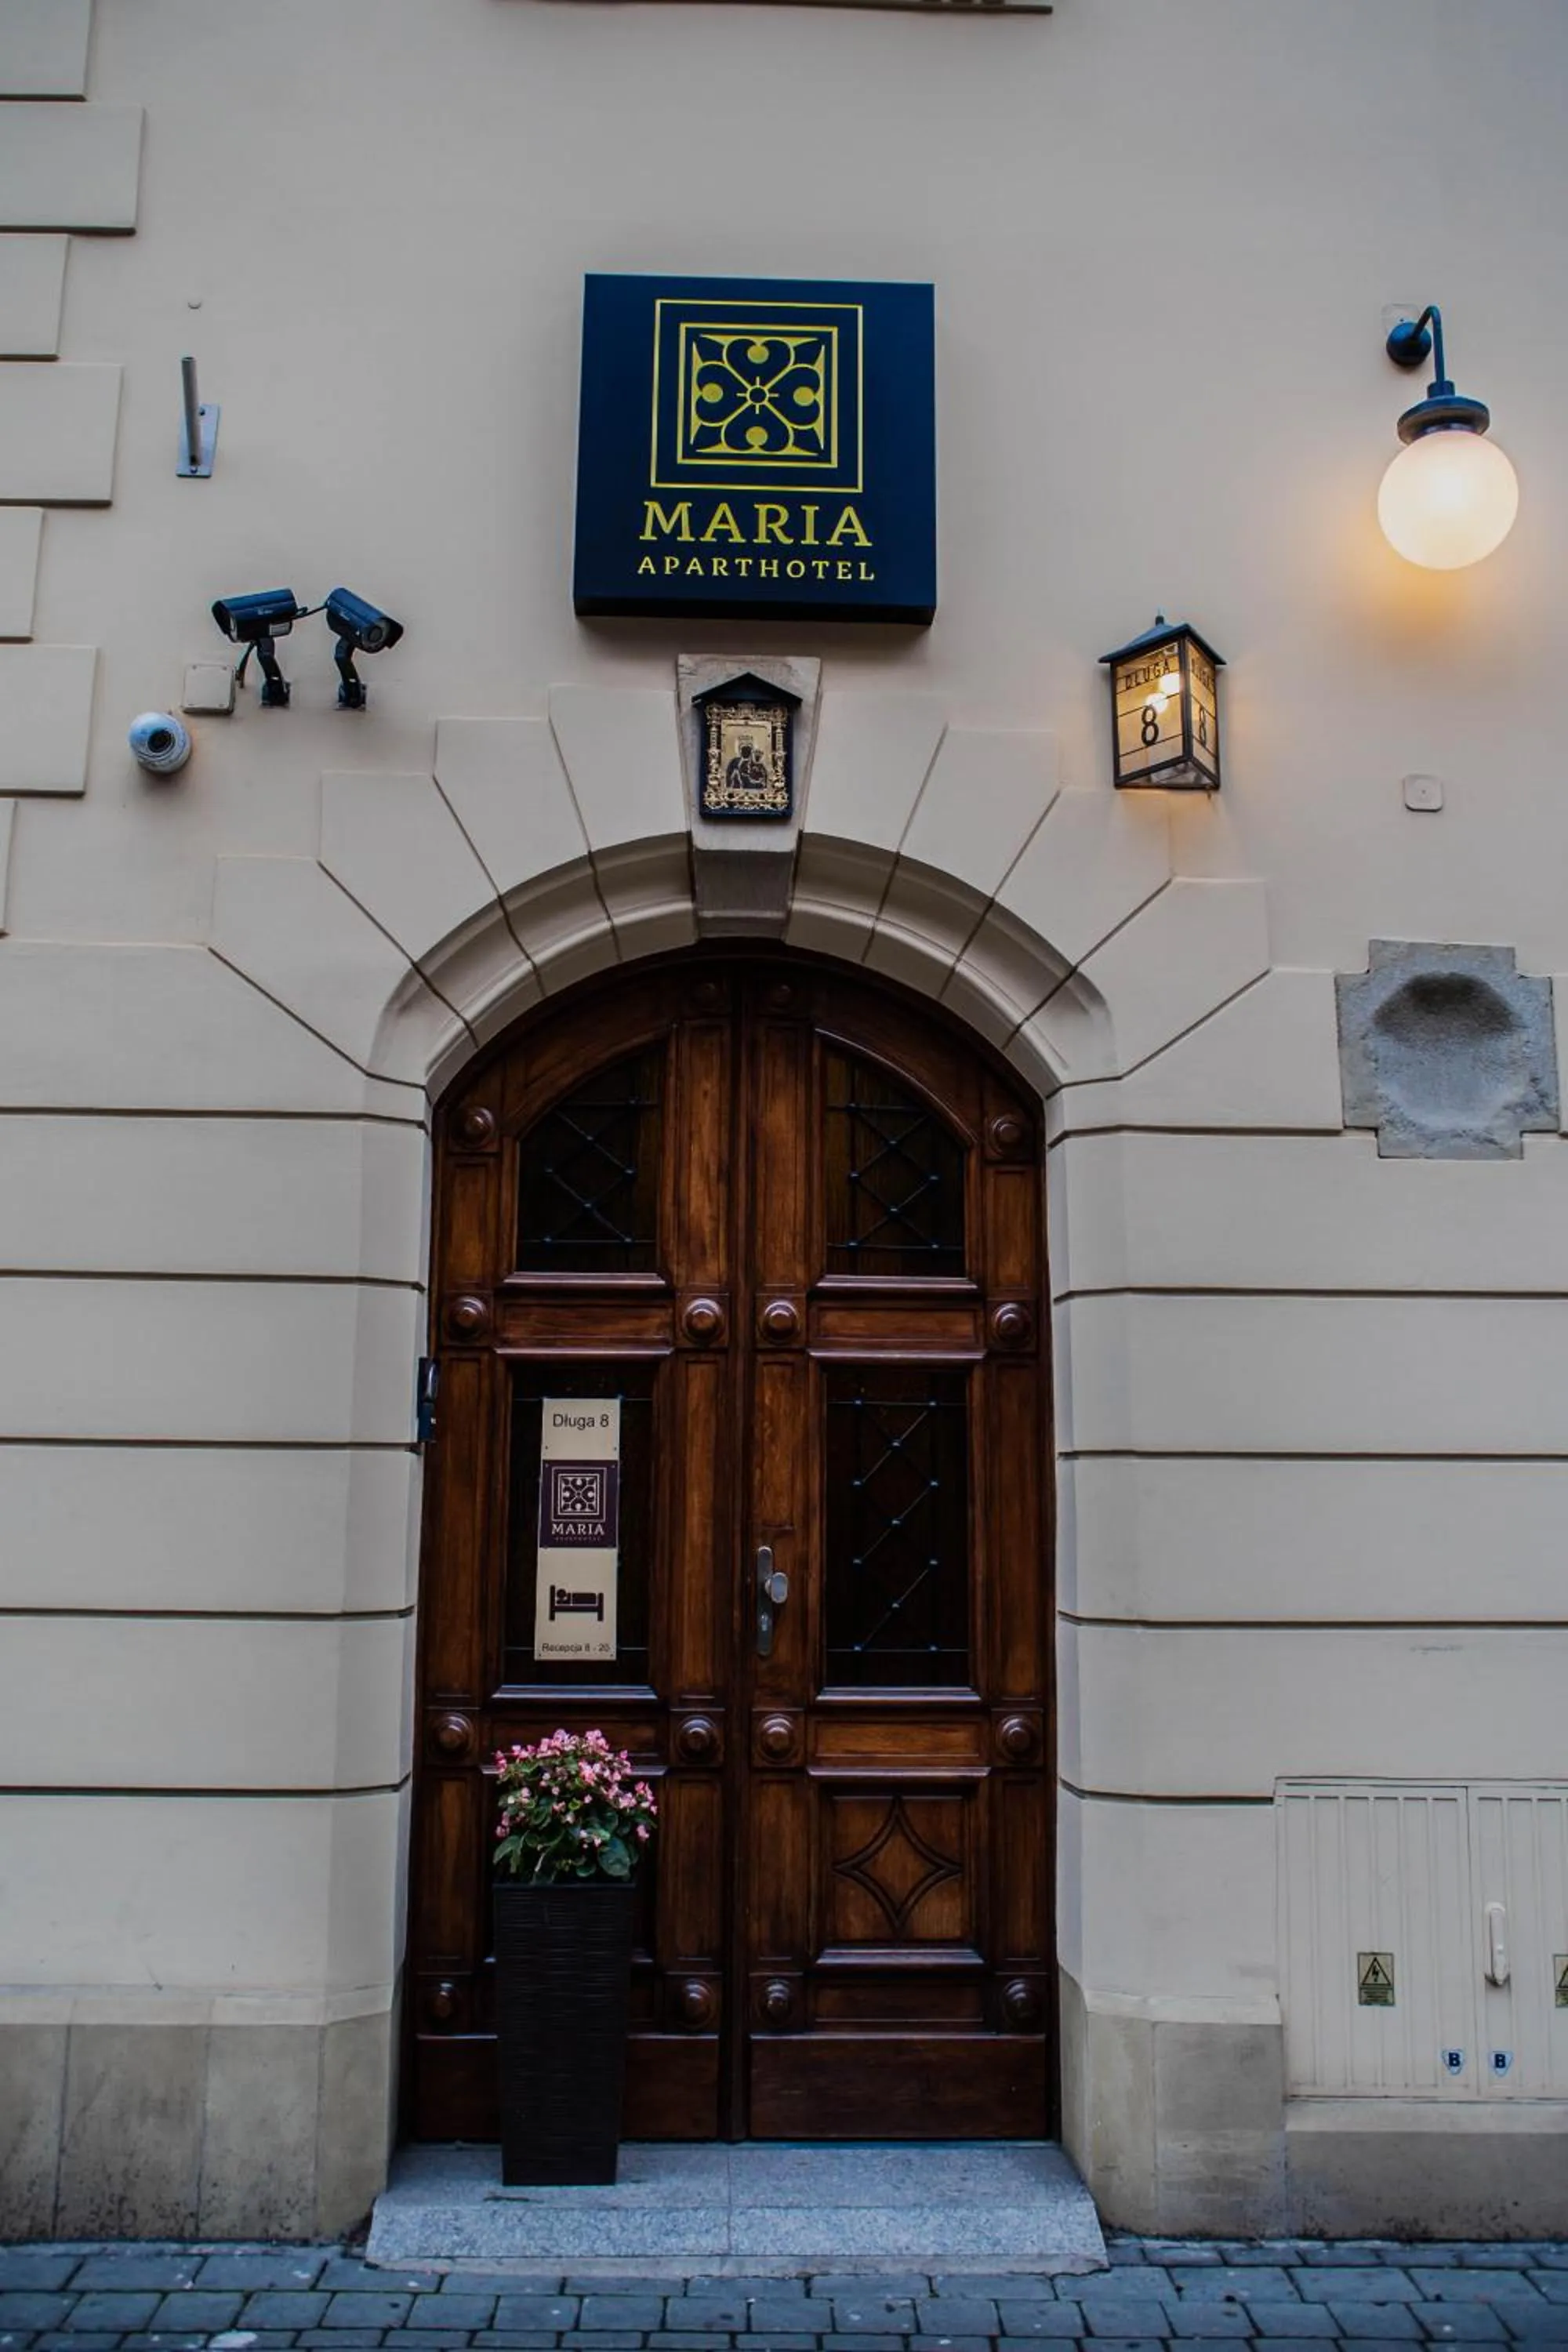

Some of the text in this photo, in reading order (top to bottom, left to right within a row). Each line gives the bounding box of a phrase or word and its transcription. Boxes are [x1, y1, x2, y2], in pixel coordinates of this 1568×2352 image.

[639, 502, 873, 546] MARIA
[637, 556, 875, 581] APARTHOTEL
[1142, 705, 1159, 746] 8
[553, 1413, 609, 1431] Długa 8
[551, 1523, 605, 1535] MARIA
[1448, 2052, 1461, 2067] B
[1494, 2053, 1506, 2069] B
